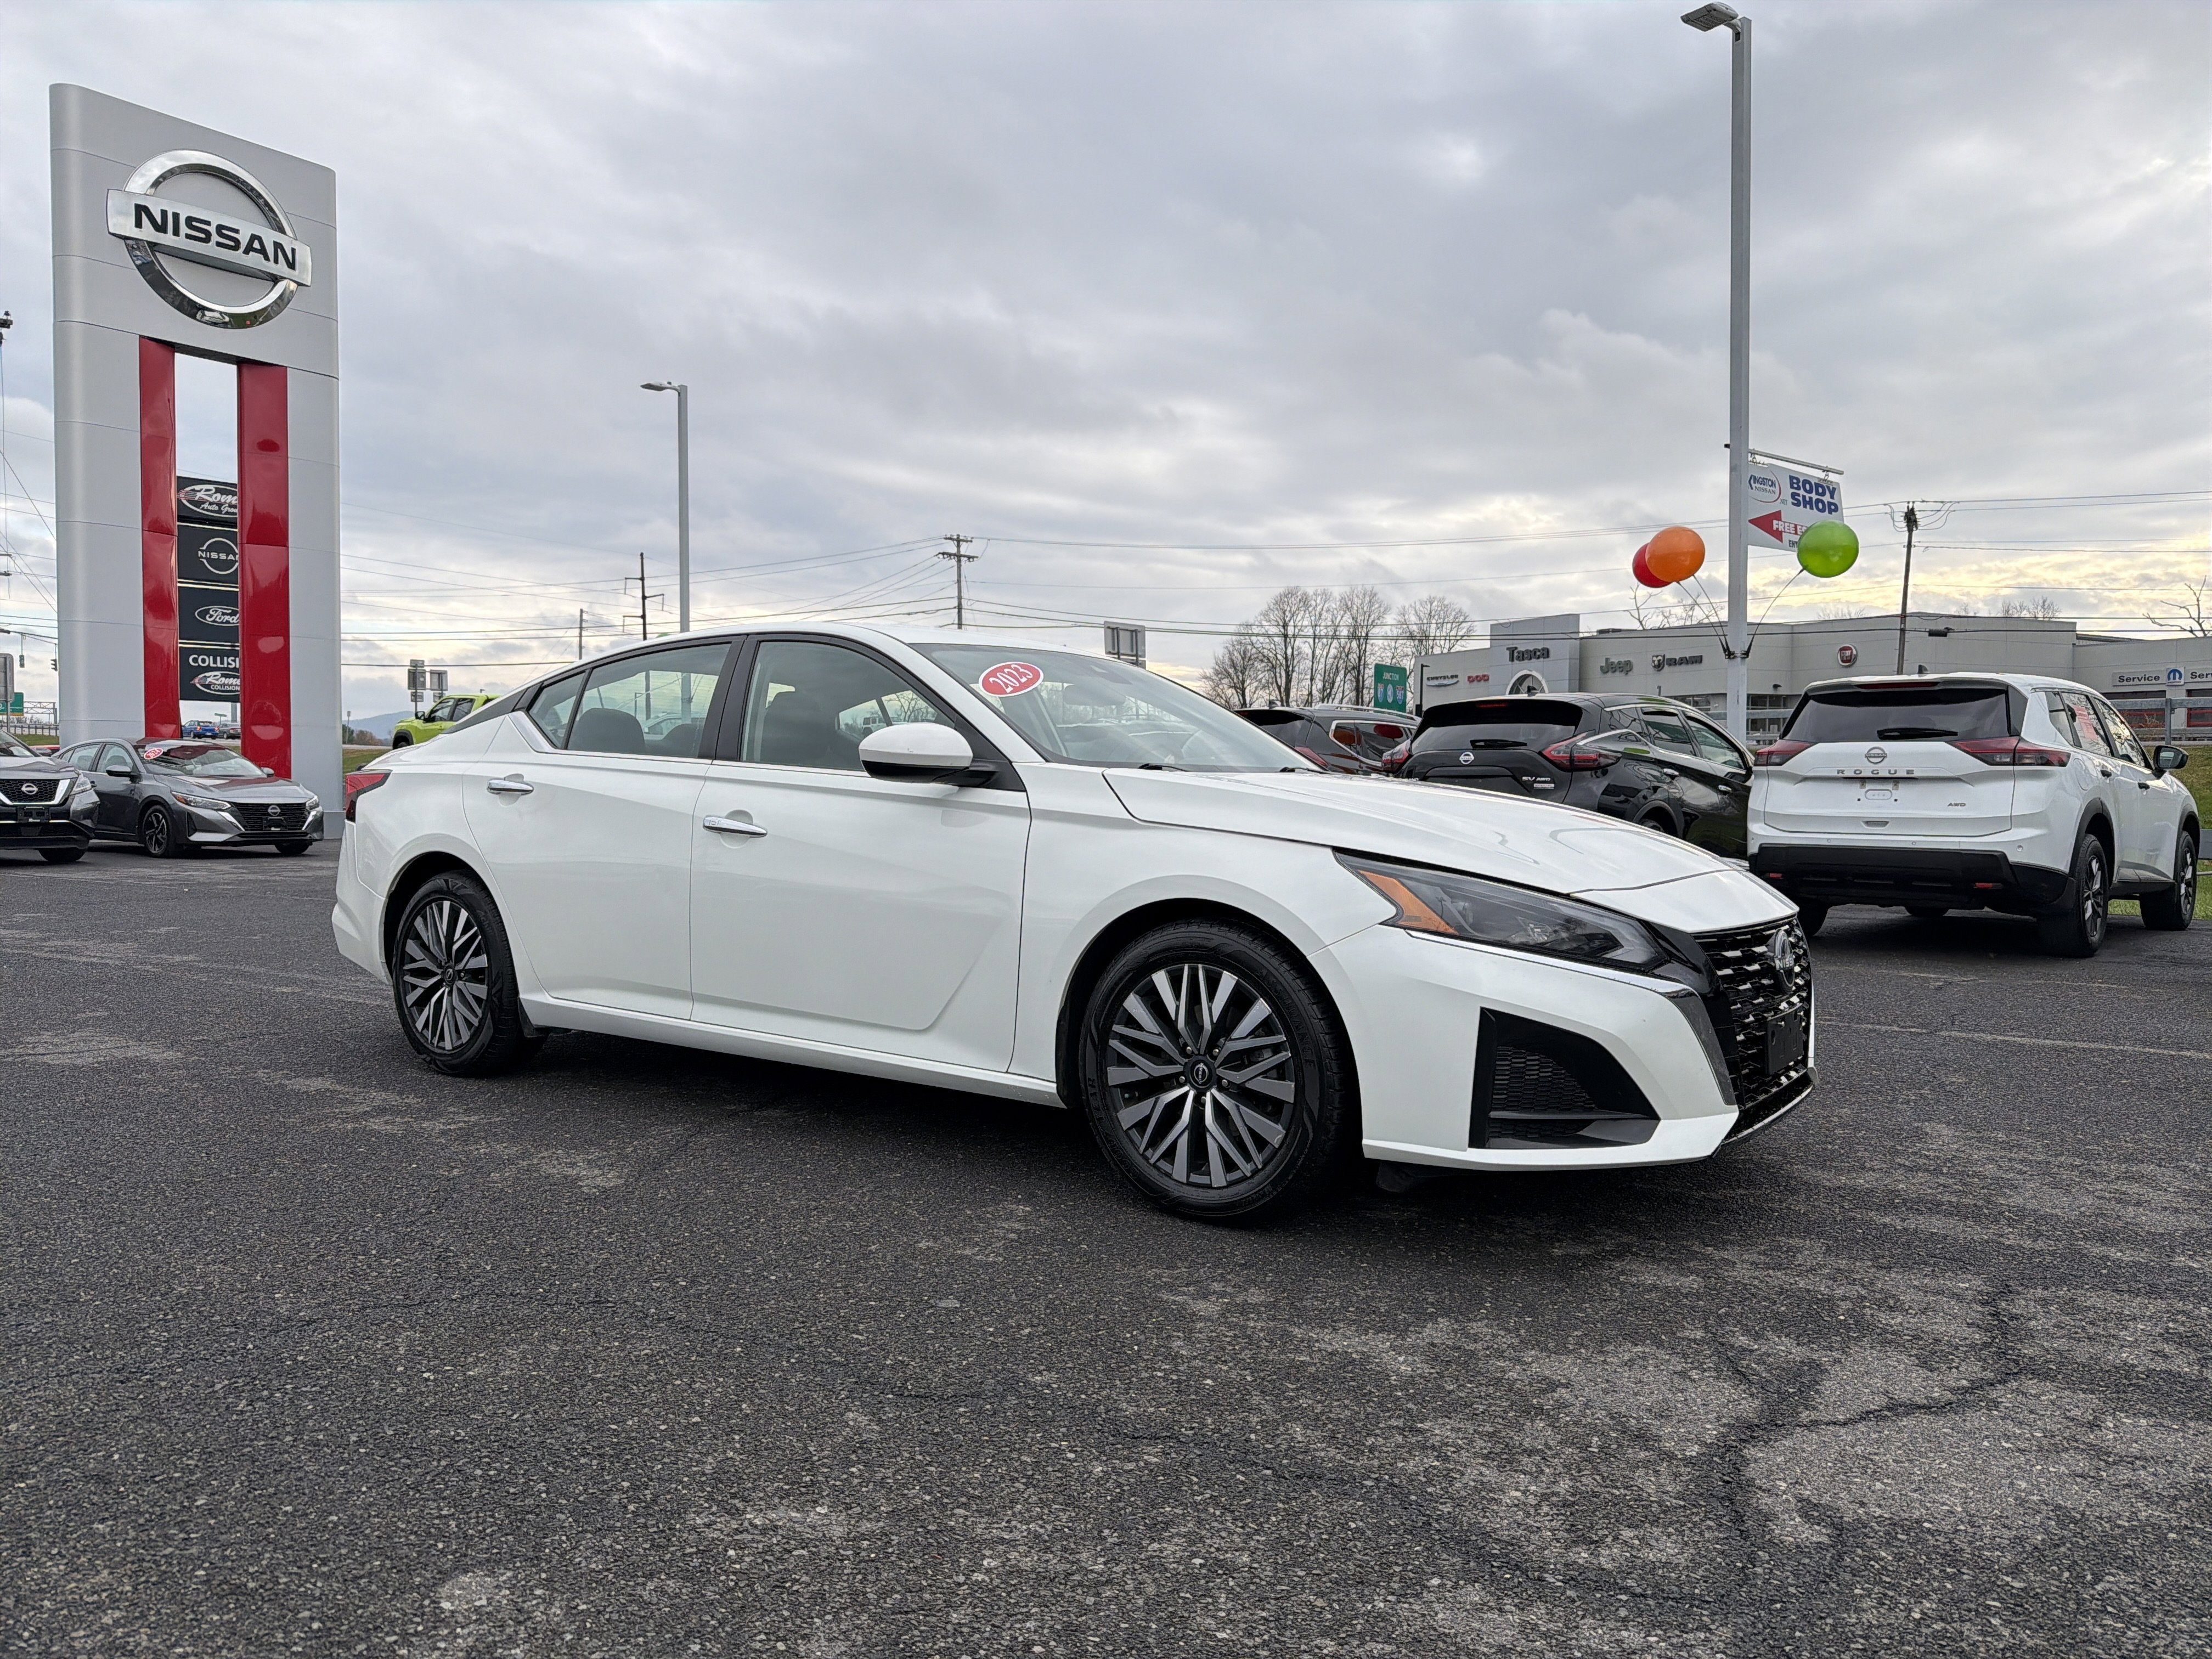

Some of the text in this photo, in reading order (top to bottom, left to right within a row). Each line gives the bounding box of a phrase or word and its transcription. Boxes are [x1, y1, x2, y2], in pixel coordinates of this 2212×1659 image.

[134, 202, 297, 271] NISSAN
[1754, 486, 1776, 495] NISSAN
[1789, 475, 1837, 500] BODY
[200, 501, 219, 511] Auto
[1790, 492, 1839, 515] SHOP
[1773, 519, 1796, 534] FREE
[206, 608, 239, 623] Ford
[1506, 646, 1550, 663] Tasca
[1666, 654, 1703, 667] RAM
[1600, 657, 1634, 676] Jeep
[989, 664, 1033, 693] 2023
[1383, 672, 1399, 681] JUNCTION
[2118, 674, 2160, 683] Service
